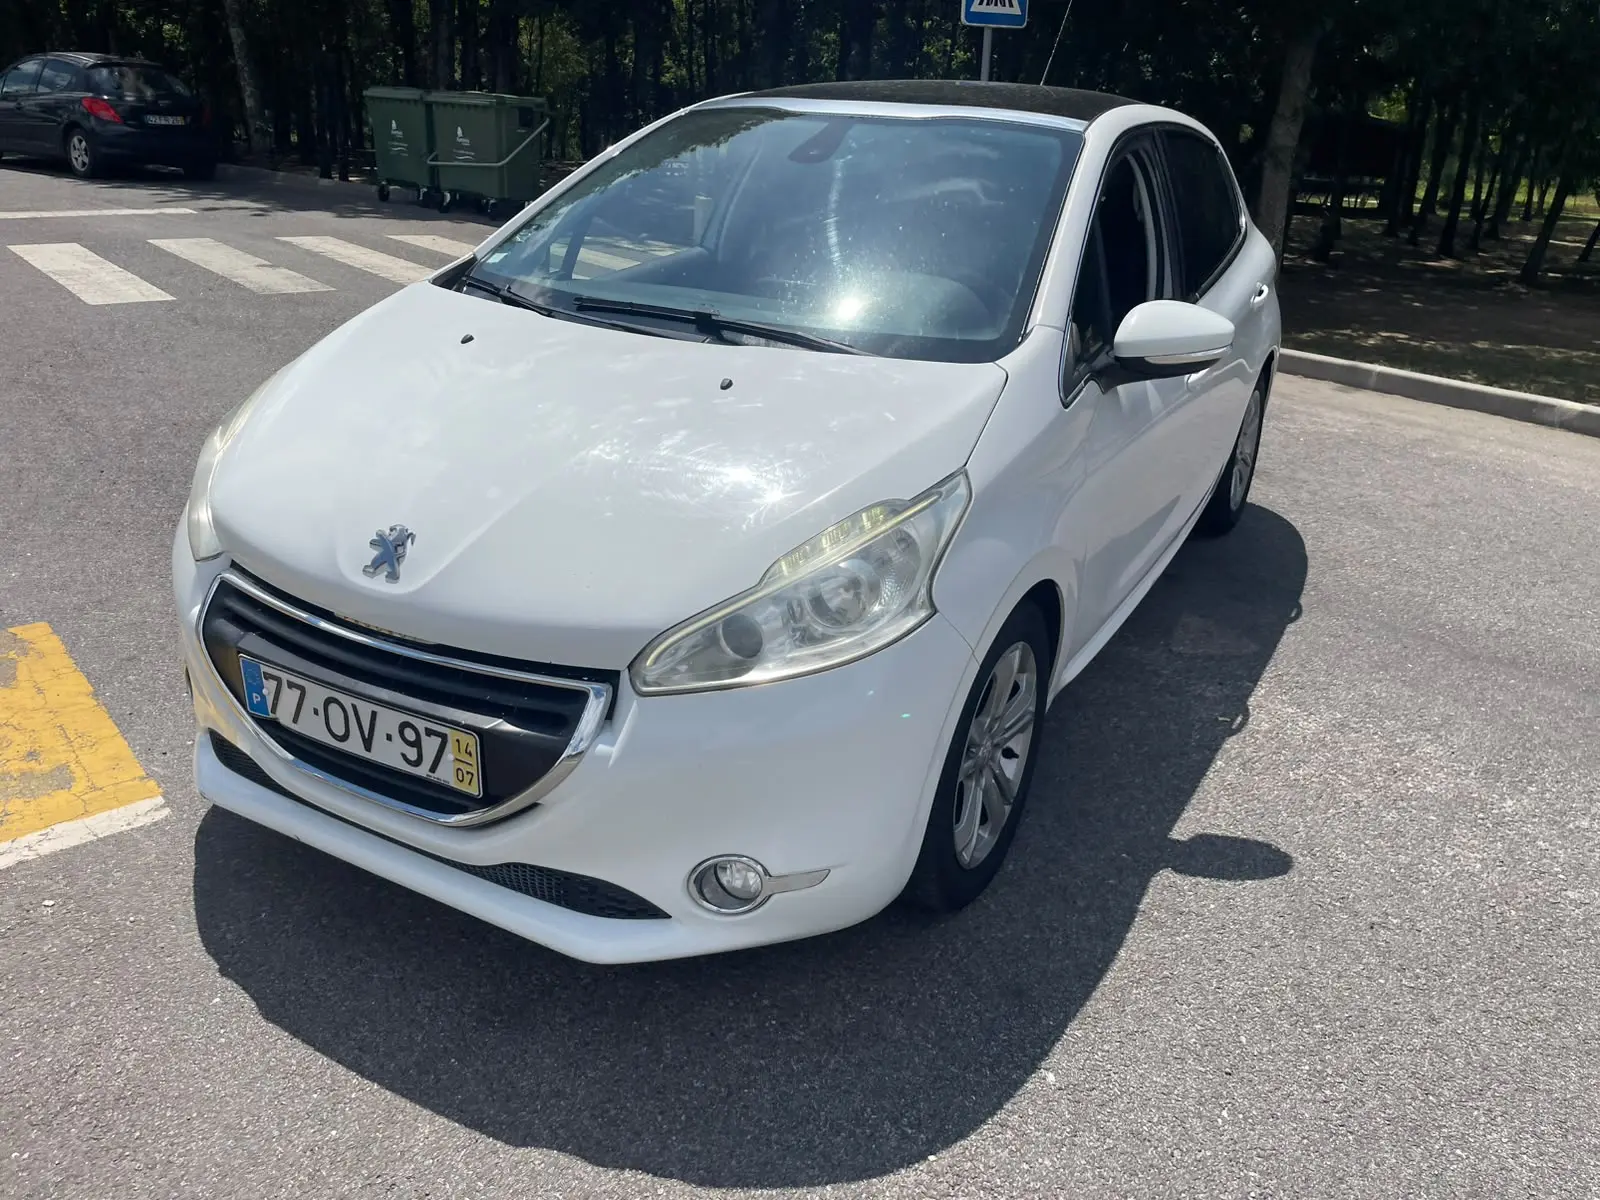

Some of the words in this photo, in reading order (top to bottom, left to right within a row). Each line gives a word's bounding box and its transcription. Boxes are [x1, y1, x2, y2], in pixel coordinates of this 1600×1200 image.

[252, 692, 262, 705] P
[455, 738, 473, 758] 14
[456, 767, 474, 786] 07
